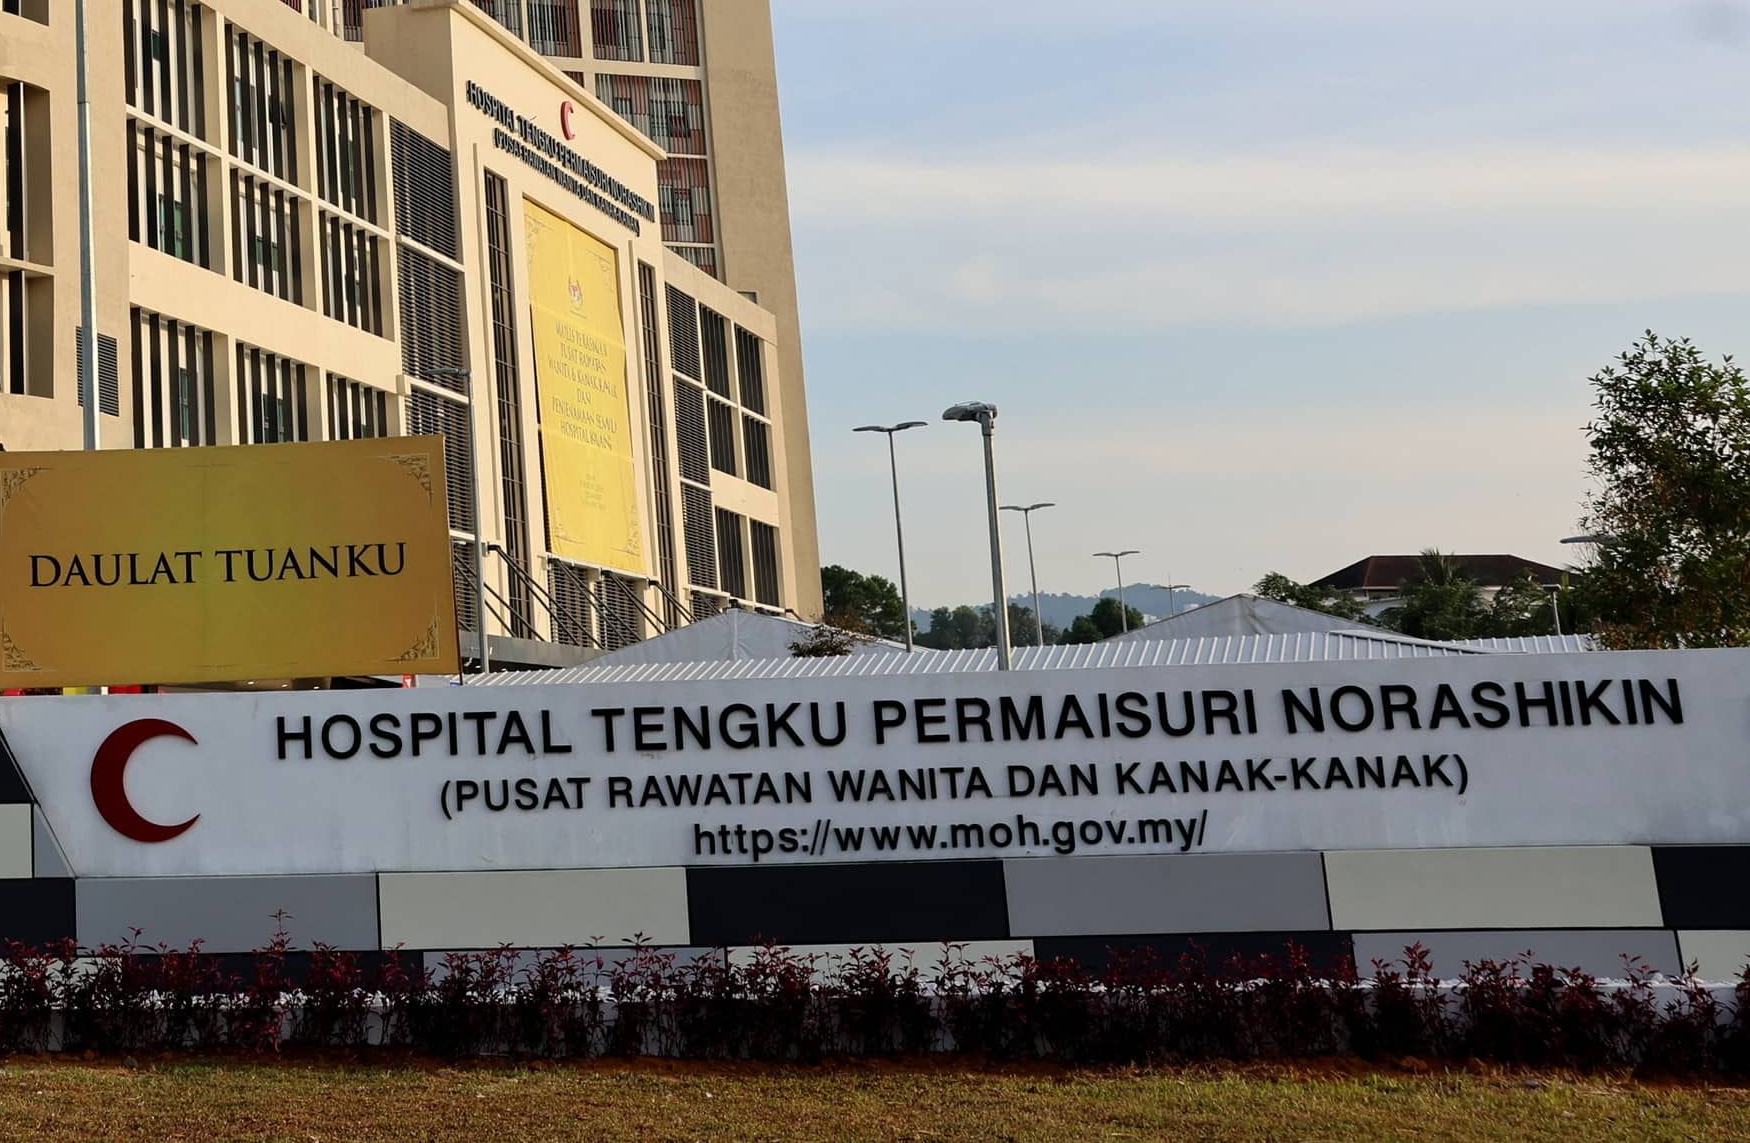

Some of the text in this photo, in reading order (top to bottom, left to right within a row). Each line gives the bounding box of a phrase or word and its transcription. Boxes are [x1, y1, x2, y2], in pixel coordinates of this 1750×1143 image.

[28, 542, 406, 587] DAULAT TUANKU
[275, 678, 1685, 761] HOSPITAL TENGKU PERMAISURI NORASHIKIN
[440, 753, 1469, 821] (PUSAT RAWATAN WANITA DAN KANAK-KANAK)
[693, 809, 1209, 863] https://www.moh.gov.my/
